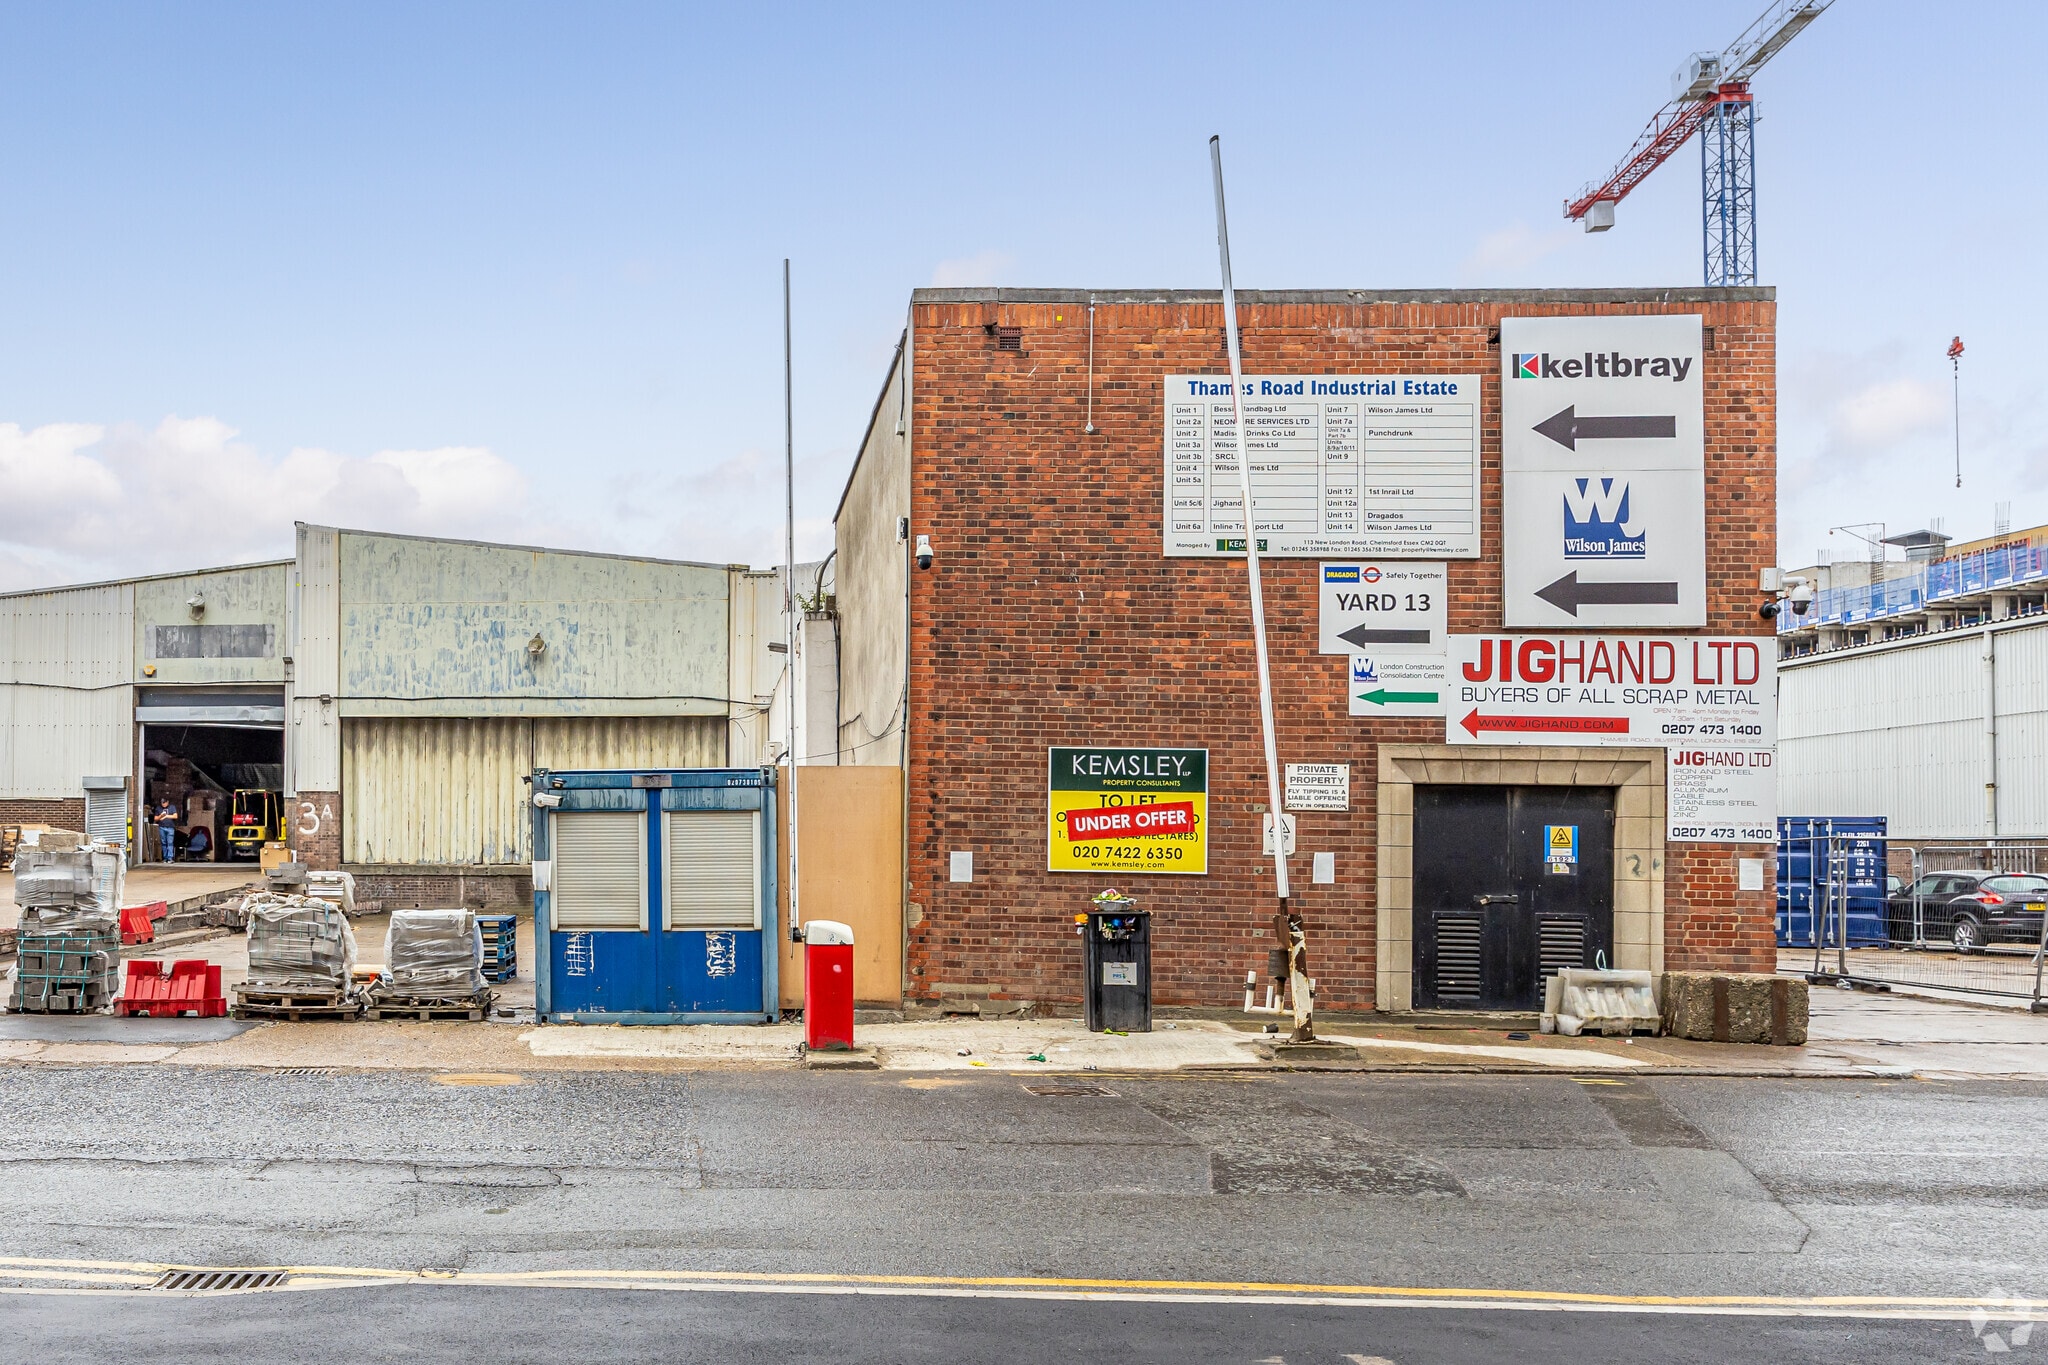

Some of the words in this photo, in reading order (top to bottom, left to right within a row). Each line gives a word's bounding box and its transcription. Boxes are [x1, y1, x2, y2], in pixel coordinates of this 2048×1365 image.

[1542, 352, 1693, 382] keltbray
[1261, 380, 1304, 396] Road
[1311, 379, 1396, 396] Industrial
[1403, 380, 1458, 396] Estate
[1368, 406, 1393, 414] Wilson
[1395, 406, 1419, 414] James
[1420, 406, 1433, 414] Ltd
[1368, 429, 1413, 437] Punchdrunk
[1381, 488, 1401, 496] Inrail
[1402, 488, 1414, 496] Ltd
[1212, 500, 1242, 508] Jighand
[1367, 512, 1404, 520] Dragados
[1419, 524, 1432, 532] Ltd
[1176, 542, 1204, 550] Managed
[1205, 542, 1210, 550] By
[1564, 538, 1606, 553] Wilson
[1606, 538, 1645, 556] James
[1326, 571, 1358, 579] DRAGADOS
[1386, 572, 1409, 580] Safely
[1410, 572, 1443, 580] Together
[1335, 593, 1397, 611] YARD
[1404, 593, 1431, 612] 13
[1462, 639, 1676, 685] JIGHAND
[1693, 641, 1760, 685] LTD
[1461, 687, 1539, 703] BUYERS
[1546, 687, 1572, 703] OF
[1578, 688, 1615, 704] ALL
[1622, 688, 1688, 704] SCRAP
[1696, 689, 1760, 705] METAL
[1692, 708, 1706, 716] 4pm
[1707, 708, 1732, 716] Monday
[1741, 708, 1760, 716] Friday
[1713, 715, 1742, 724] Saturday
[1661, 724, 1695, 735] 0207
[1699, 724, 1724, 735] 473
[1729, 725, 1762, 736] 1400
[1673, 751, 1744, 767] JIGHAND
[1749, 752, 1772, 768] LTD
[1072, 755, 1187, 776] KEMSLEY
[1297, 765, 1338, 773] PRIVATE
[1102, 779, 1135, 787] PROPERTY
[1136, 779, 1181, 788] CONSULTANTS
[1289, 776, 1345, 785] PROPERTY
[1099, 794, 1124, 809] TO
[1673, 811, 1696, 819] ZINC
[1074, 812, 1132, 833] UNDER
[1134, 809, 1187, 829] OFFER
[1672, 827, 1706, 838] 0207
[1710, 828, 1735, 839] 473
[1740, 829, 1773, 839] 1400
[1072, 845, 1100, 859] 020
[1105, 846, 1141, 860] 7422
[1146, 846, 1183, 861] 6350
[1090, 859, 1165, 870] www.kemsley.com
